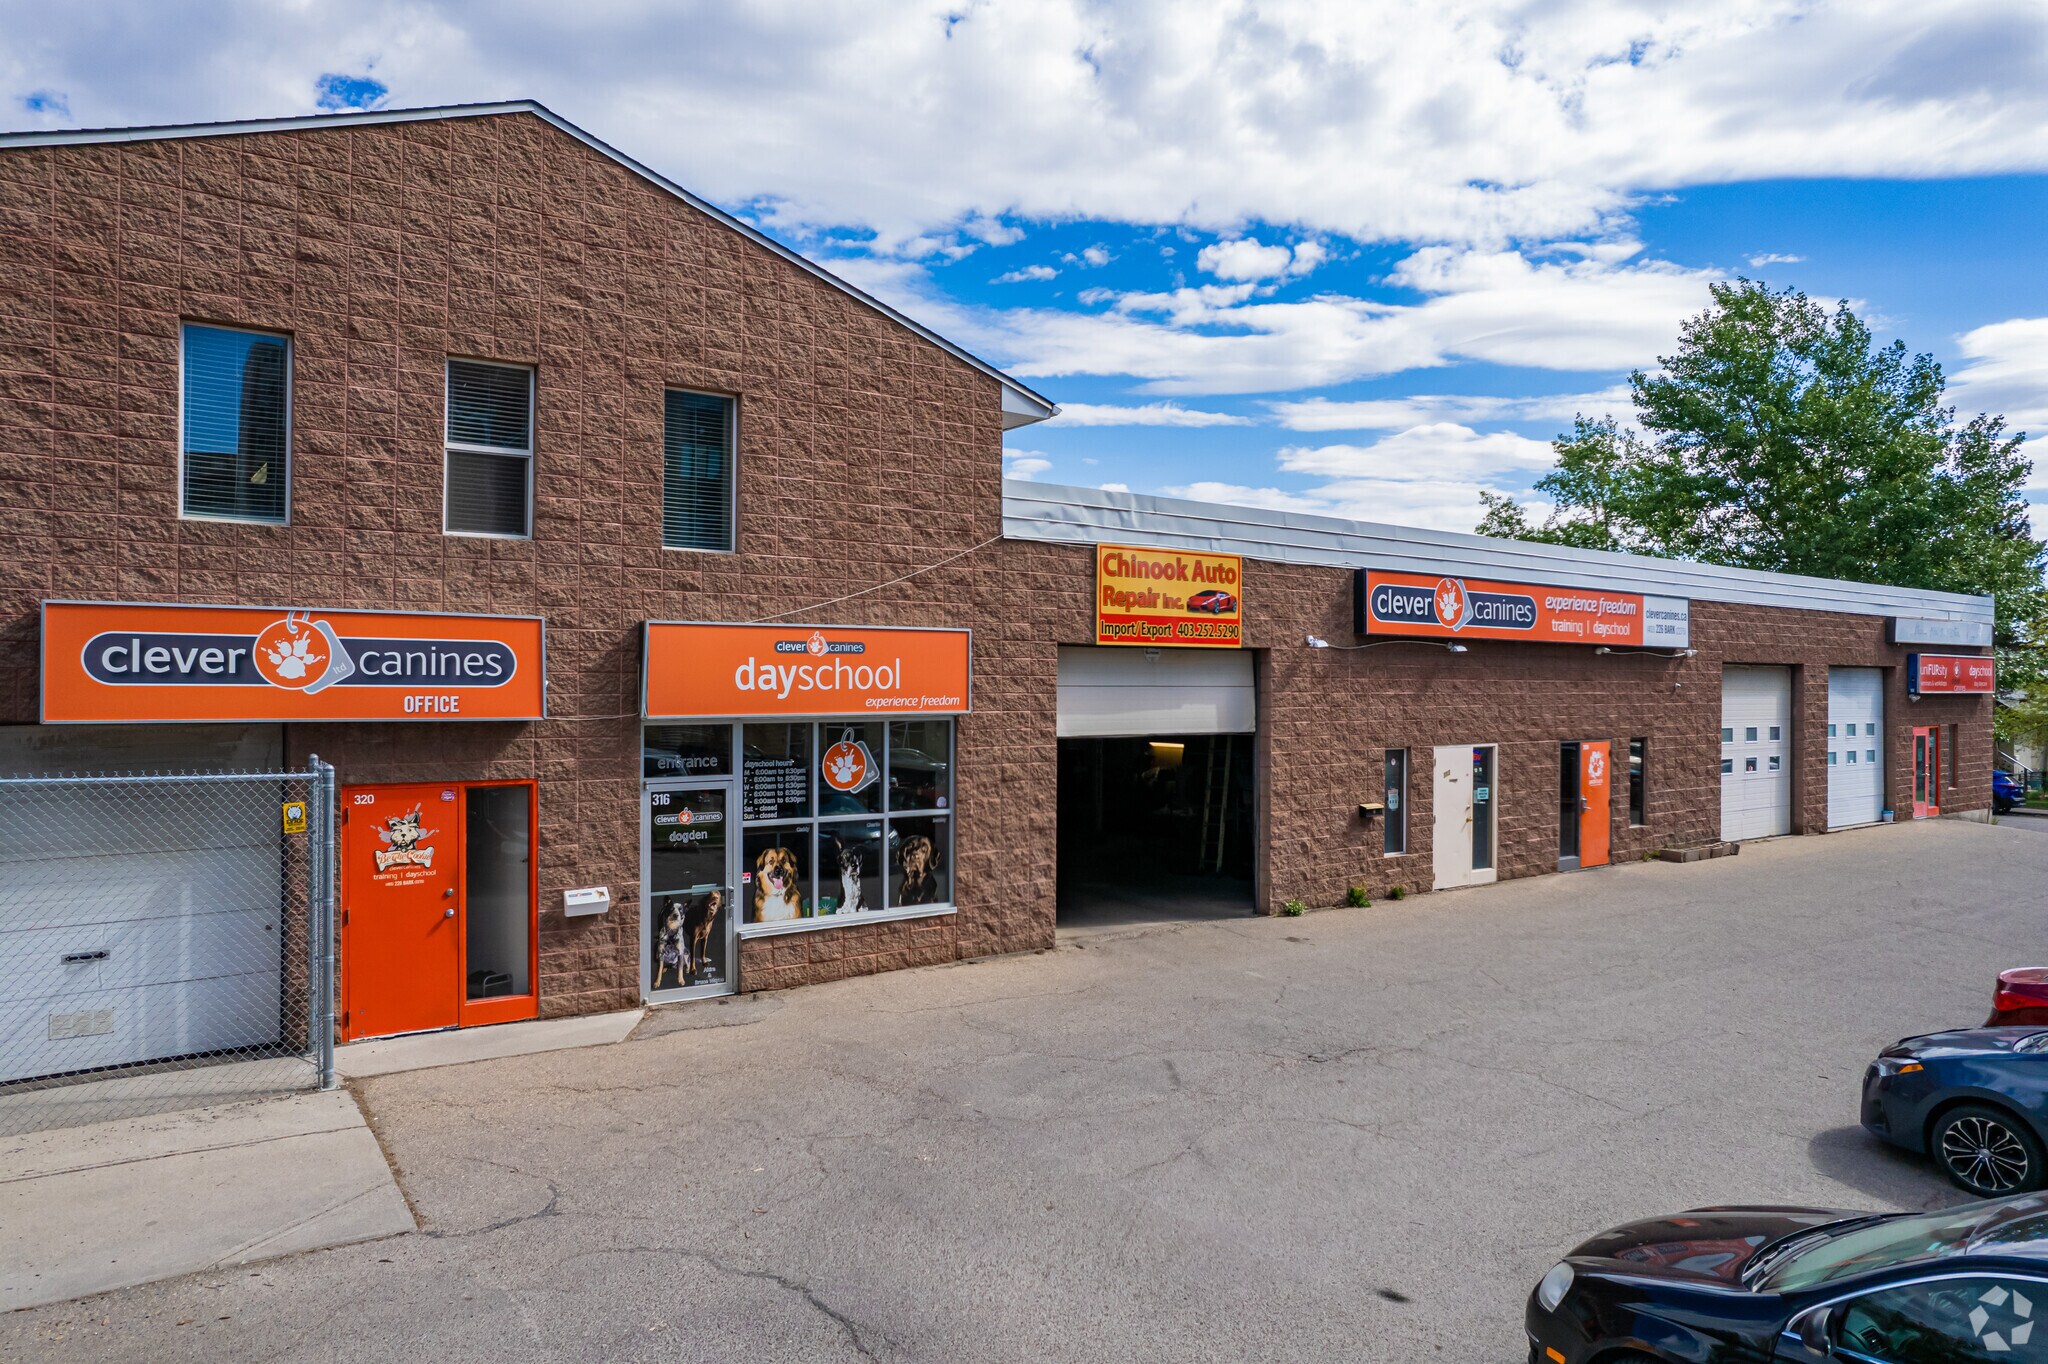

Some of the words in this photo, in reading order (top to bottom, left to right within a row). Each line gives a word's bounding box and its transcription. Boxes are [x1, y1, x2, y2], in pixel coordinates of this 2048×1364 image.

[1102, 552, 1189, 581] Chinook
[1192, 560, 1236, 584] Auto
[1102, 585, 1160, 612] Repair
[1162, 593, 1184, 610] Inc.
[1377, 589, 1432, 615] clever
[1475, 599, 1532, 622] canines
[1546, 596, 1597, 613] experience
[1598, 598, 1636, 616] freedom
[1646, 608, 1687, 621] clevercanines.ca
[1178, 622, 1239, 638] 403.252.5290
[1552, 619, 1583, 636] training
[1593, 620, 1630, 637] dayschool
[777, 642, 806, 651] clever
[829, 642, 863, 652] canines
[102, 639, 246, 673] clever
[333, 662, 347, 675] ltd
[360, 646, 503, 677] canines
[735, 657, 900, 699] dayschool
[1969, 665, 1992, 678] dayschool
[404, 696, 459, 712] OFFICE
[866, 696, 918, 709] experience
[919, 695, 960, 709] freedom
[658, 755, 718, 769] entrance
[354, 794, 374, 805] 320
[652, 794, 670, 806] 316
[669, 830, 708, 843] dogden
[406, 870, 436, 878] dayschool
